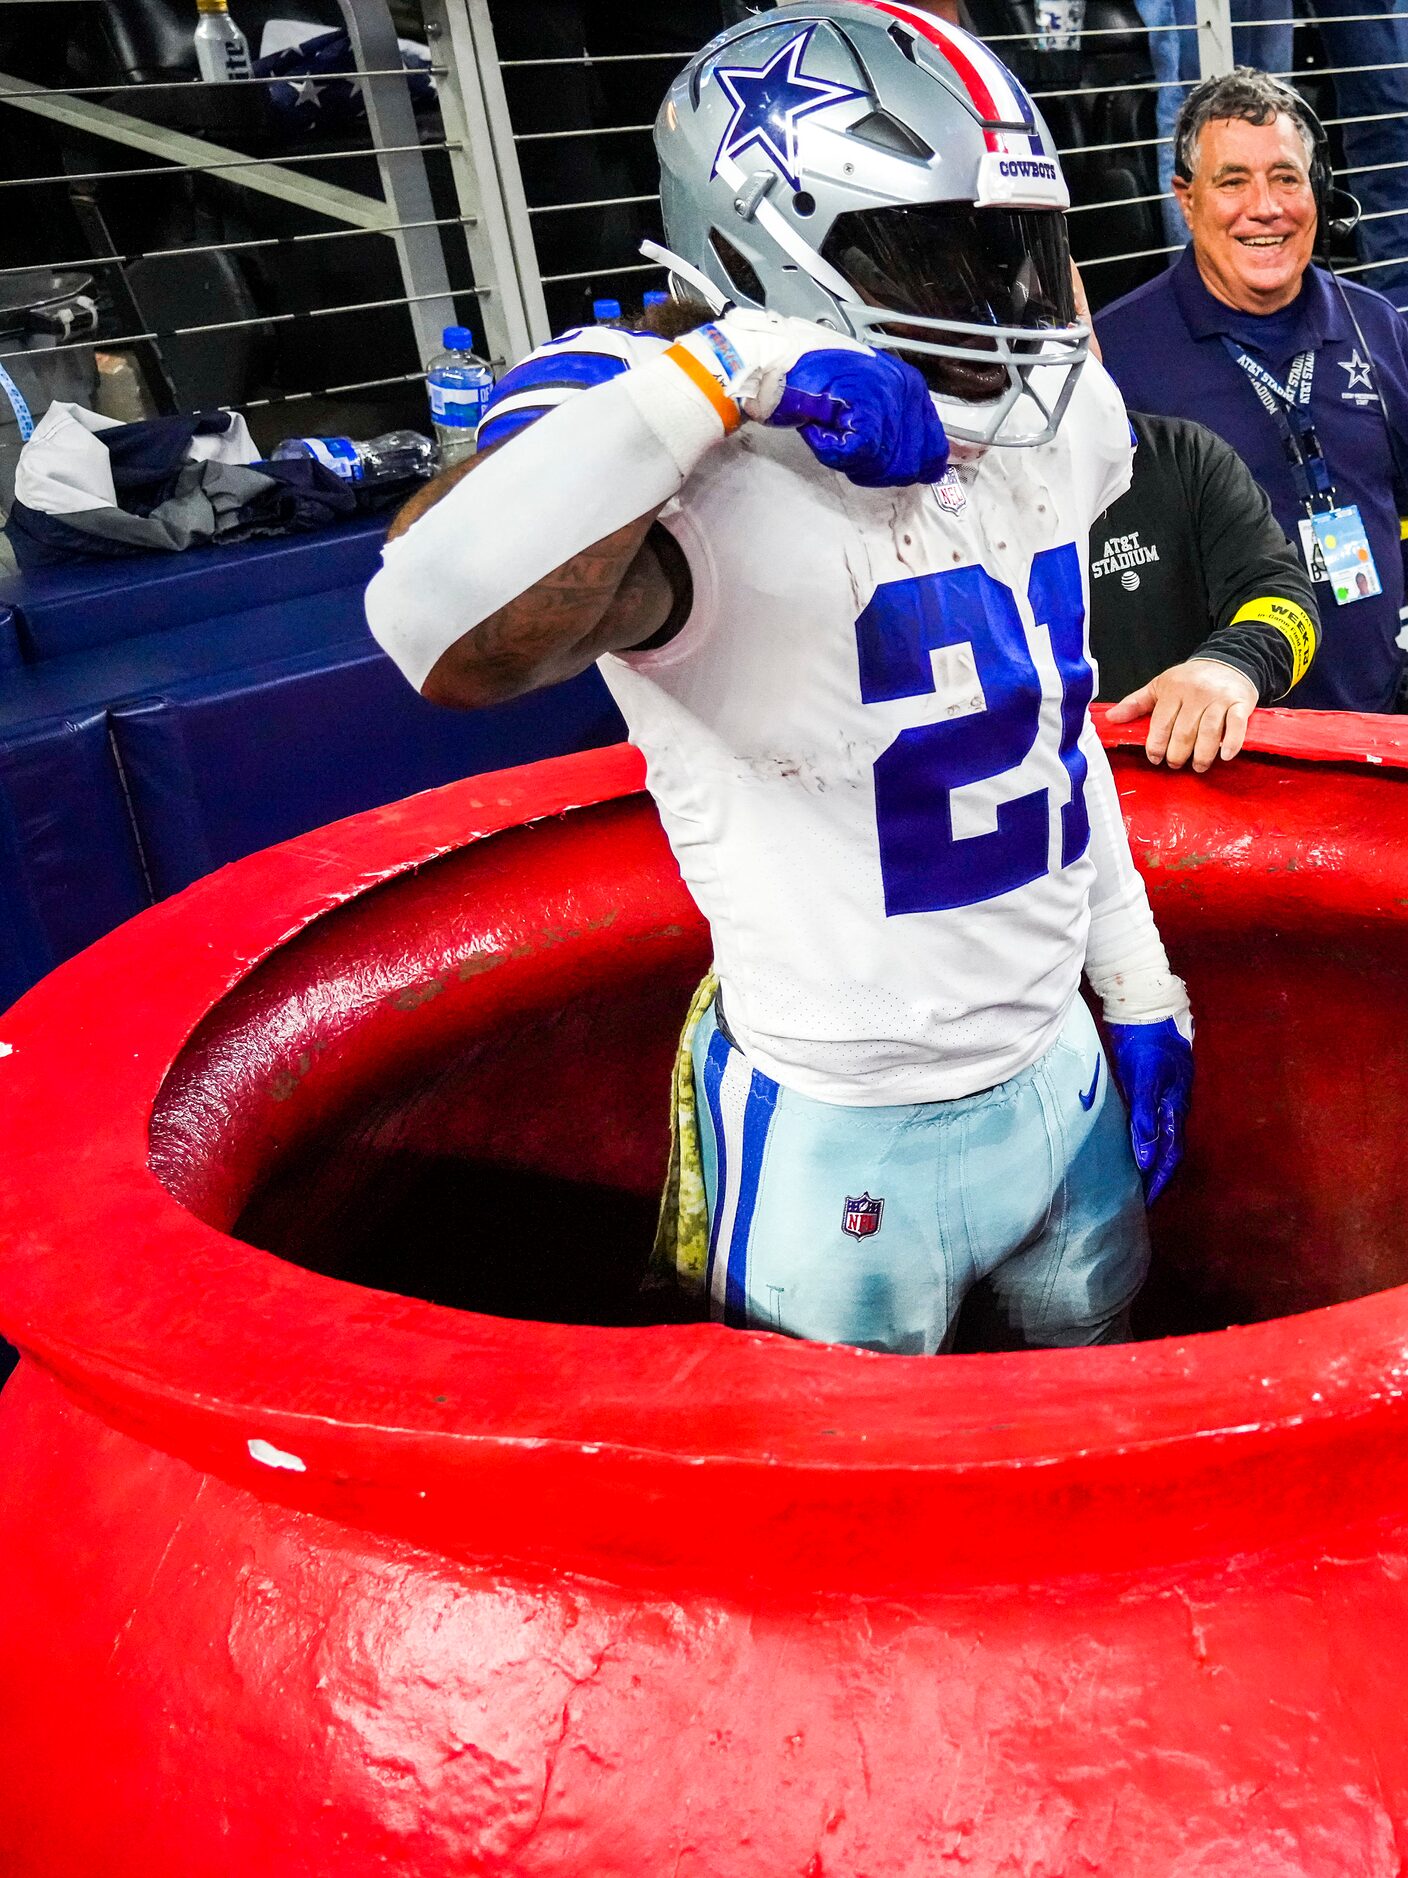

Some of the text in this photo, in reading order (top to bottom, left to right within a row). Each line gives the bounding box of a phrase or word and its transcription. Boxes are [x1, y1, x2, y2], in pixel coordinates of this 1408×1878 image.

[999, 160, 1057, 180] COWBOYS
[1236, 354, 1264, 378] AT&T
[1103, 531, 1140, 558] AT&T
[1091, 544, 1160, 579] STADIUM
[1271, 604, 1310, 647] WEEK
[854, 541, 1094, 917] 21
